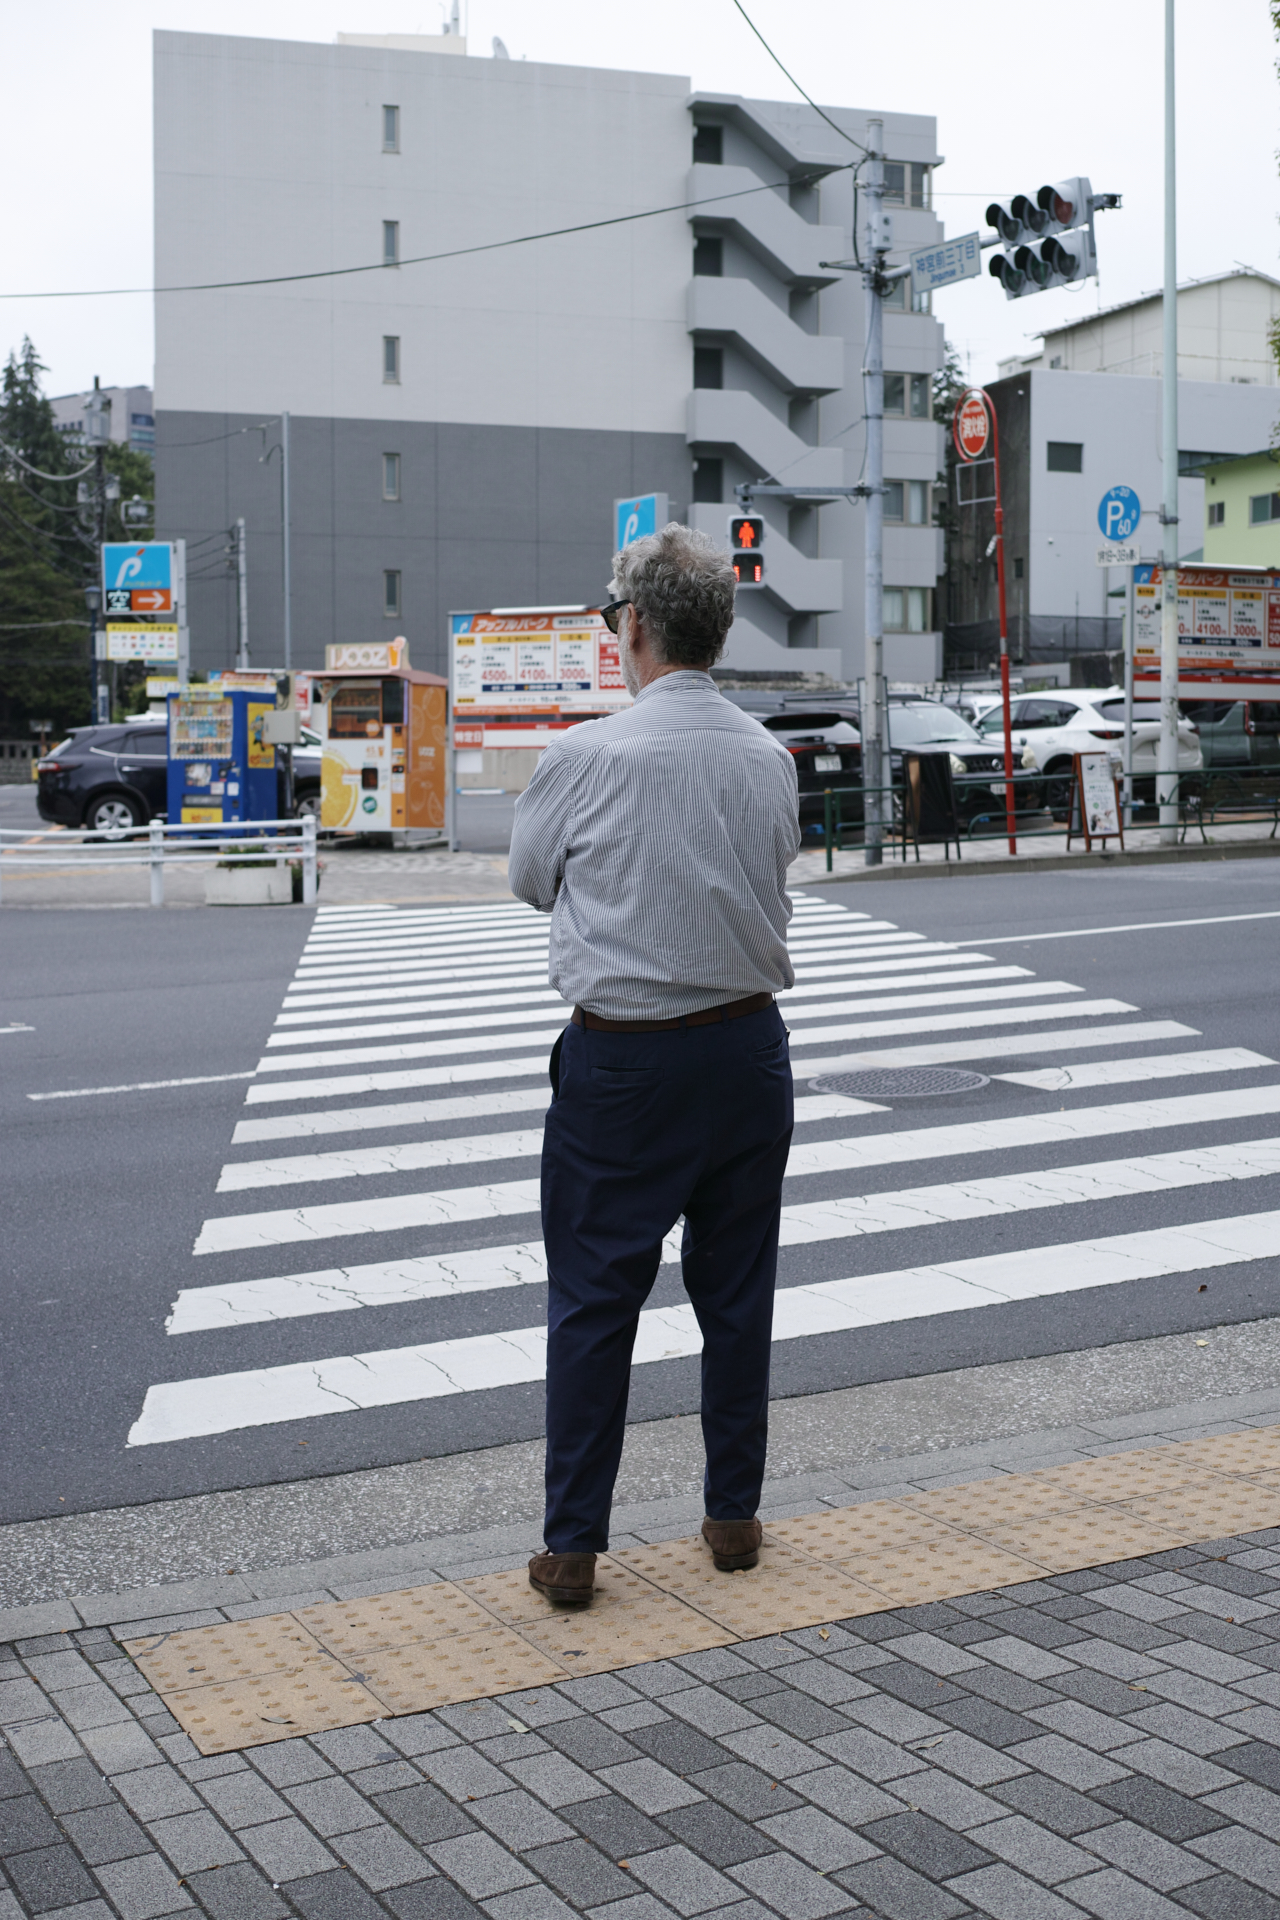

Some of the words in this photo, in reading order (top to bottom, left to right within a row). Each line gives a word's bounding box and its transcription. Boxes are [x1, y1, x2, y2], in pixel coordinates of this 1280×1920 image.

[915, 239, 975, 276] 神宮前三丁目
[962, 415, 985, 439] 消火栓
[1105, 500, 1125, 537] P
[1117, 518, 1132, 536] 60
[107, 590, 131, 612] 空
[474, 617, 549, 633] アップルパーク
[454, 730, 482, 743] 特定日
